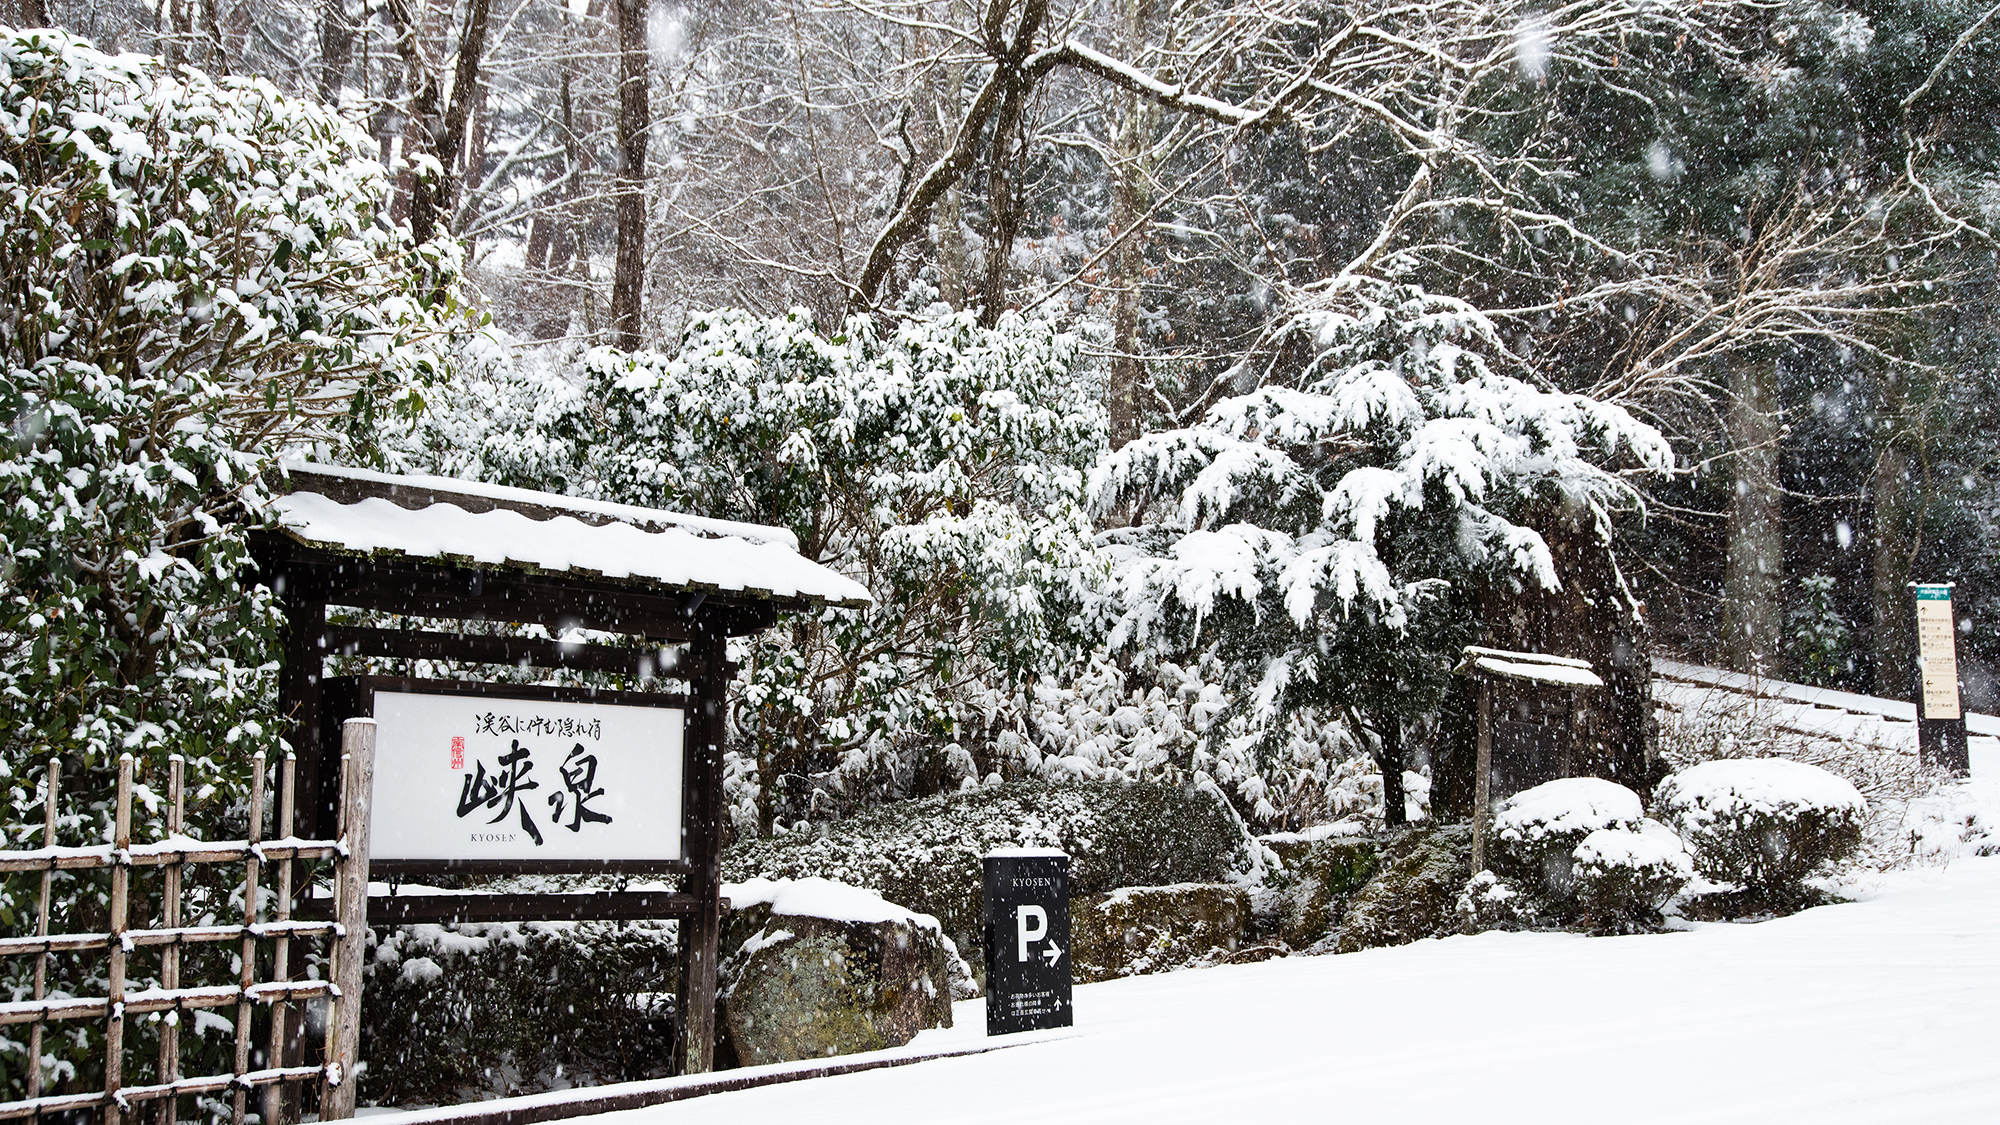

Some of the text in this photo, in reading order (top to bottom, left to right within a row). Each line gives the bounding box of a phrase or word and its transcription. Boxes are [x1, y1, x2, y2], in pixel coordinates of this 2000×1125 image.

[451, 736, 465, 769] 南信州
[456, 739, 613, 847] 峡泉
[470, 833, 517, 842] KYOSEN
[1012, 878, 1051, 887] KYOSEN
[1017, 905, 1048, 962] P
